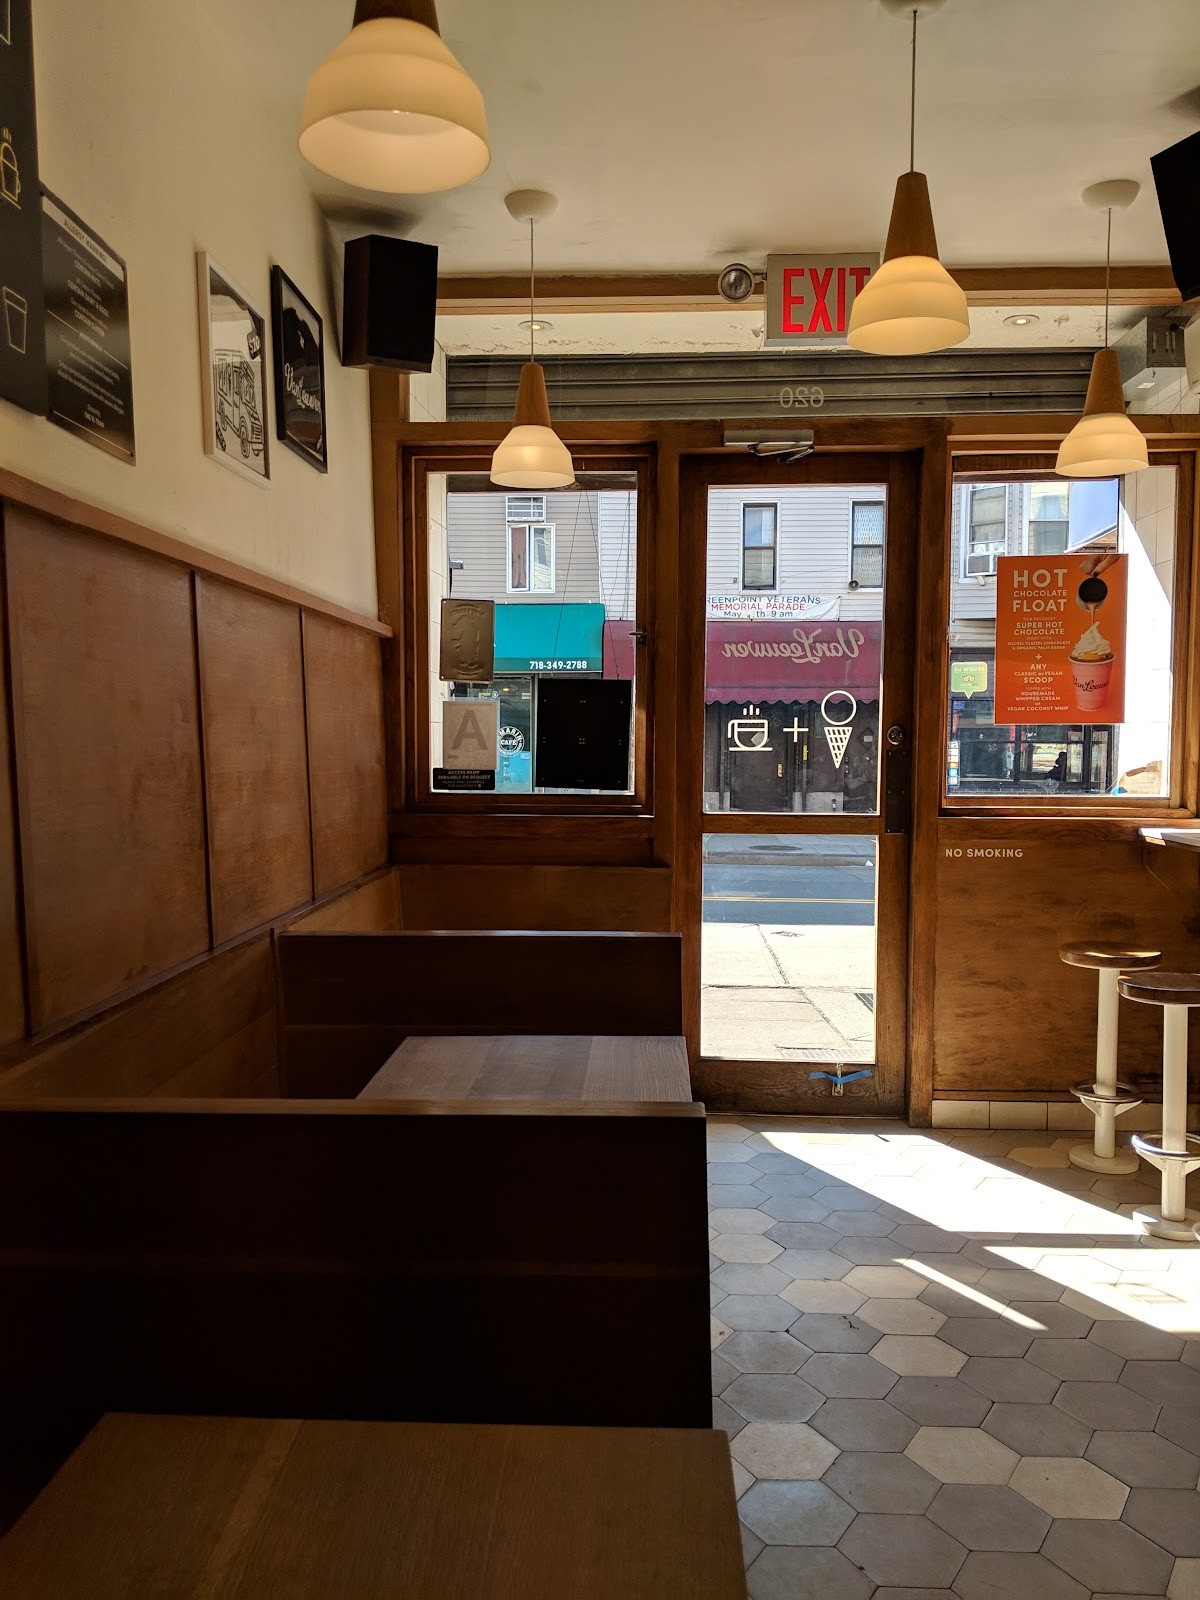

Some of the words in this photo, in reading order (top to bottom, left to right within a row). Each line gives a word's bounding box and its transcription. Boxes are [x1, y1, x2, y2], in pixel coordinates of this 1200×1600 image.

[64, 219, 84, 243] ALLERGY
[782, 267, 871, 333] EXIT
[1013, 569, 1068, 588] HOT
[1013, 589, 1068, 597] CHOCOLATE
[711, 603, 762, 611] MEMORIAL
[766, 603, 806, 611] PARADE
[767, 596, 821, 605] VETERANS
[1013, 599, 1068, 613] FLOAT
[529, 661, 588, 670] 718-349-2788
[452, 709, 488, 750] A
[498, 727, 523, 741] MARIN
[945, 848, 963, 858] NO
[966, 848, 1024, 858] SMOKING
